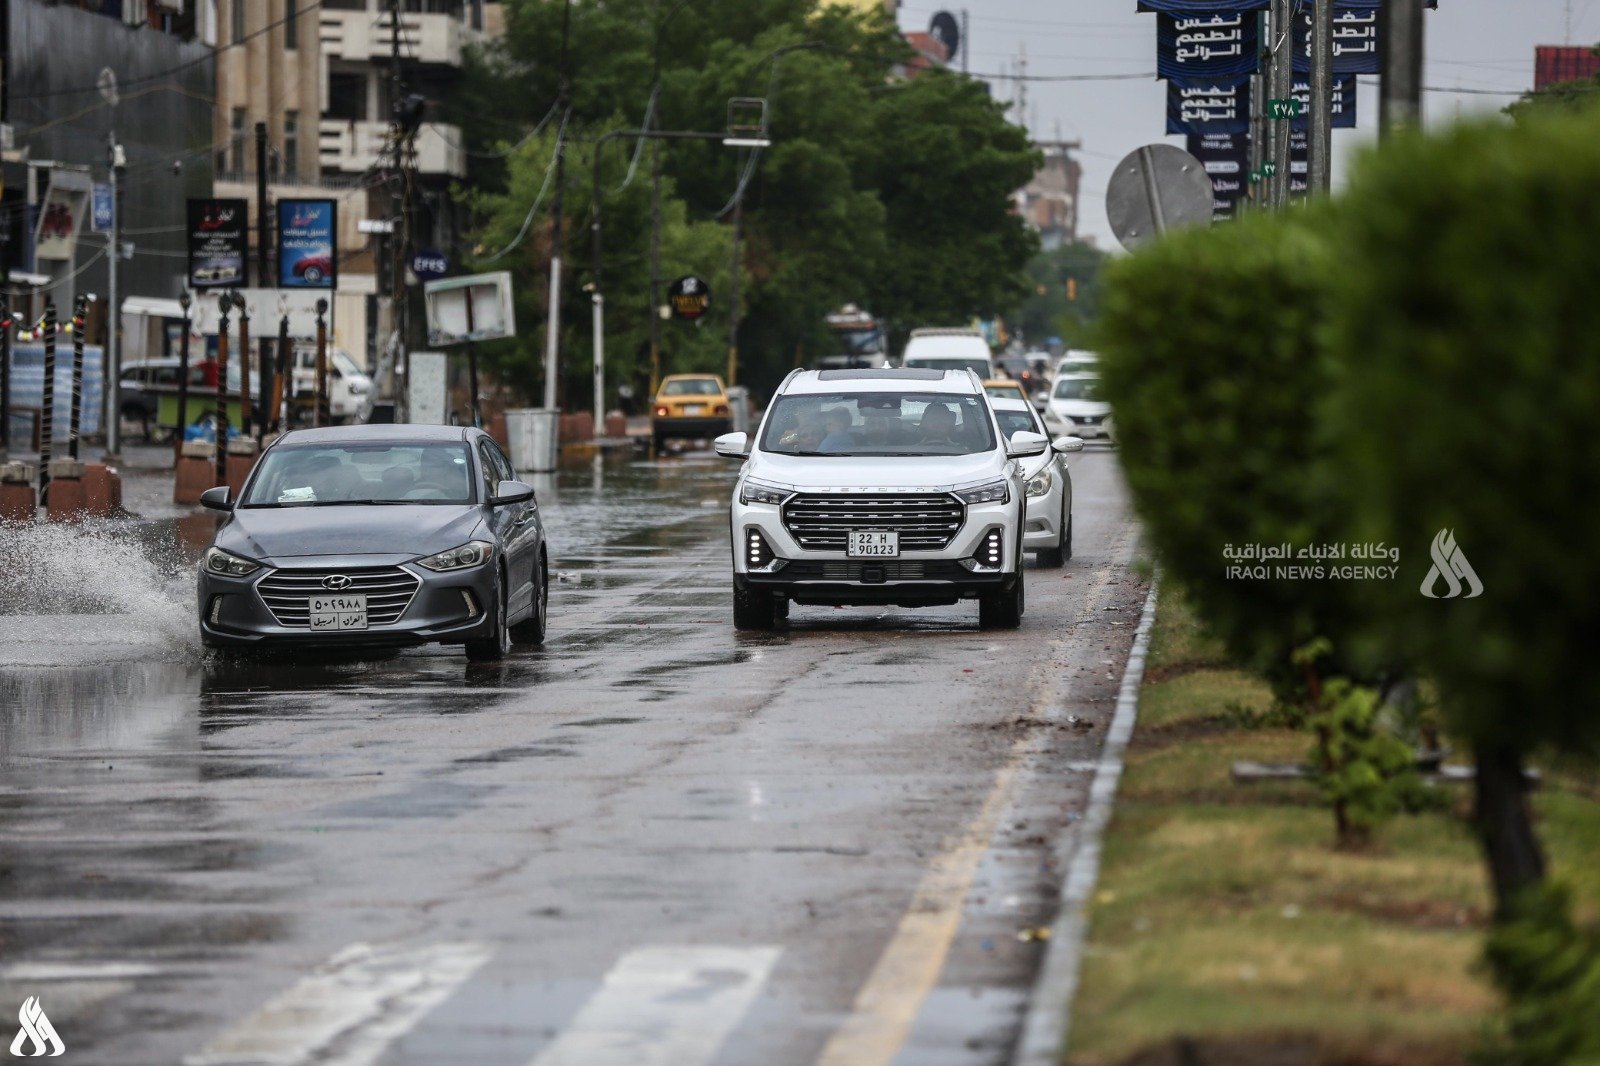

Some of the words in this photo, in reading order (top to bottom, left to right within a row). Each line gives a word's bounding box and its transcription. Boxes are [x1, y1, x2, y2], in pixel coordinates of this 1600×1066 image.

[1175, 13, 1241, 30] نفس
[1176, 29, 1241, 46] الطعم
[1176, 44, 1241, 62] الرائع
[1181, 85, 1236, 97] نفس
[1181, 98, 1236, 110] الطعم
[1181, 109, 1236, 122] الرائع
[859, 534, 872, 543] 22
[880, 534, 887, 543] H
[859, 545, 894, 554] 90123
[342, 615, 363, 626] العراق
